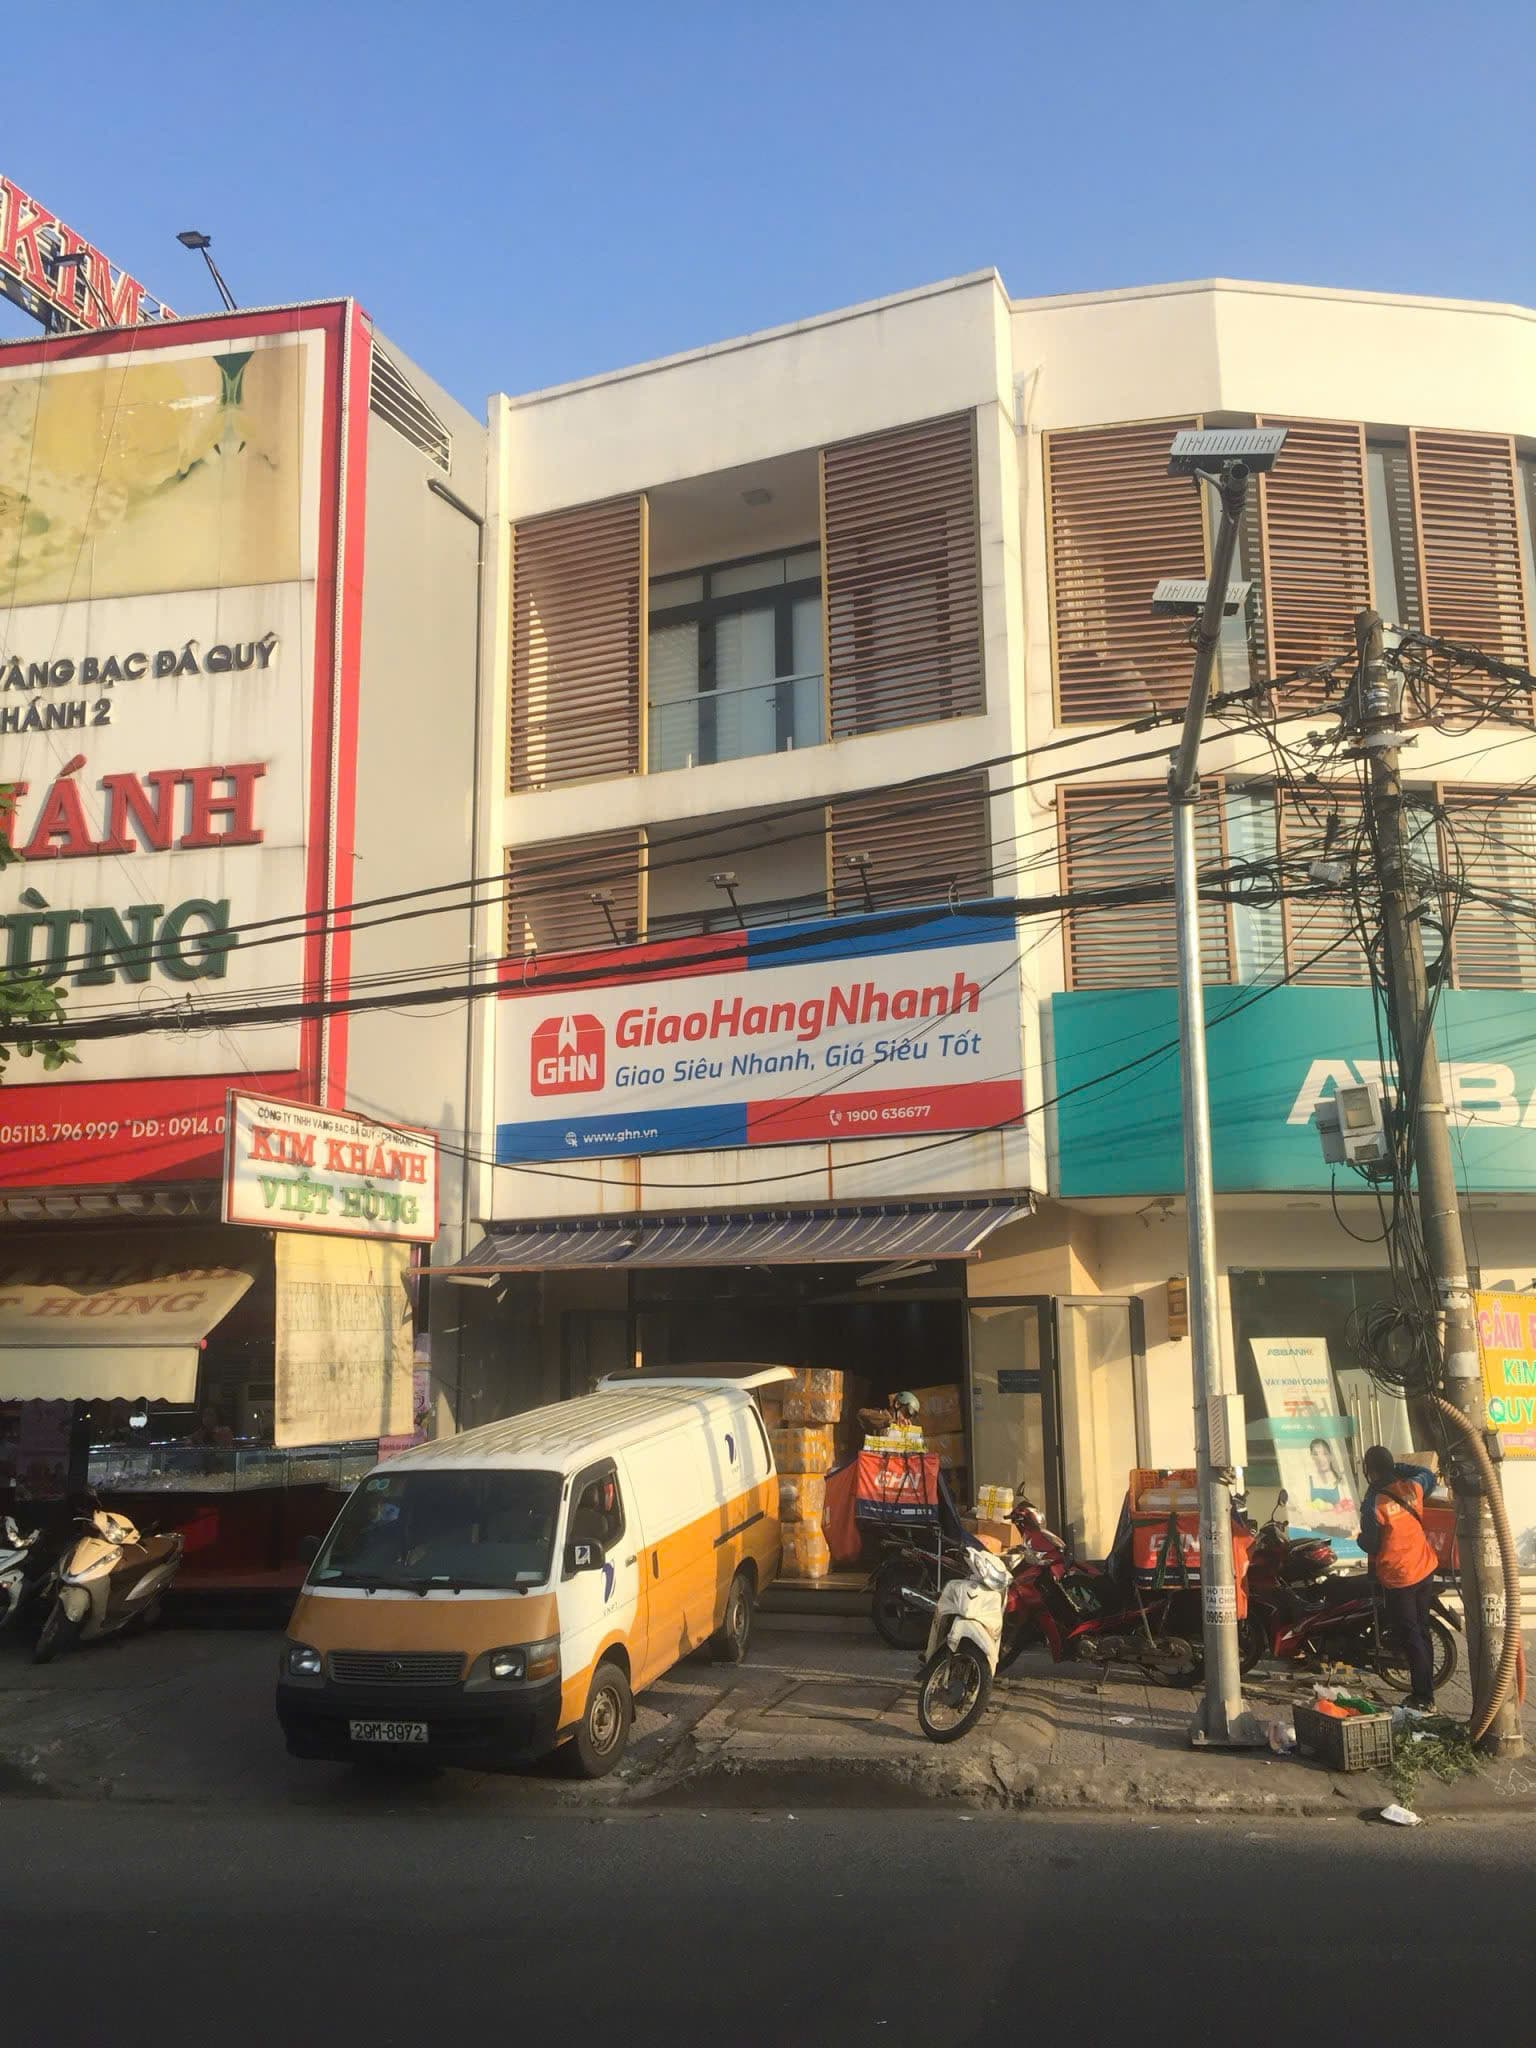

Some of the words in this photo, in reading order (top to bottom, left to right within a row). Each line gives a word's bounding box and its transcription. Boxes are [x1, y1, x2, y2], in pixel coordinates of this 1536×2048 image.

[0, 176, 146, 328] KIM
[80, 652, 149, 689] BẠC
[157, 639, 200, 678] ĐÁ
[206, 631, 279, 672] QUÝ
[94, 698, 111, 726] 2
[0, 887, 240, 984] ÙNG
[615, 972, 981, 1049] GiaoHangNhanh
[537, 1053, 597, 1085] GHN
[616, 1065, 665, 1087] Giao
[673, 1057, 723, 1082] Siêu
[731, 1050, 815, 1077] Nhanh,
[825, 1041, 865, 1067] Giá
[873, 1037, 929, 1063] Siêu
[938, 1029, 982, 1057] Tốt
[583, 1128, 658, 1145] www.ghn.vn
[847, 1109, 878, 1122] 1900
[881, 1105, 931, 1120] 636677
[249, 1124, 316, 1167] KIM
[324, 1139, 427, 1184] KHÁNH
[257, 1172, 334, 1221] VIỆT
[340, 1180, 420, 1225] HÙNG
[354, 1722, 424, 1741] 29M-8972
